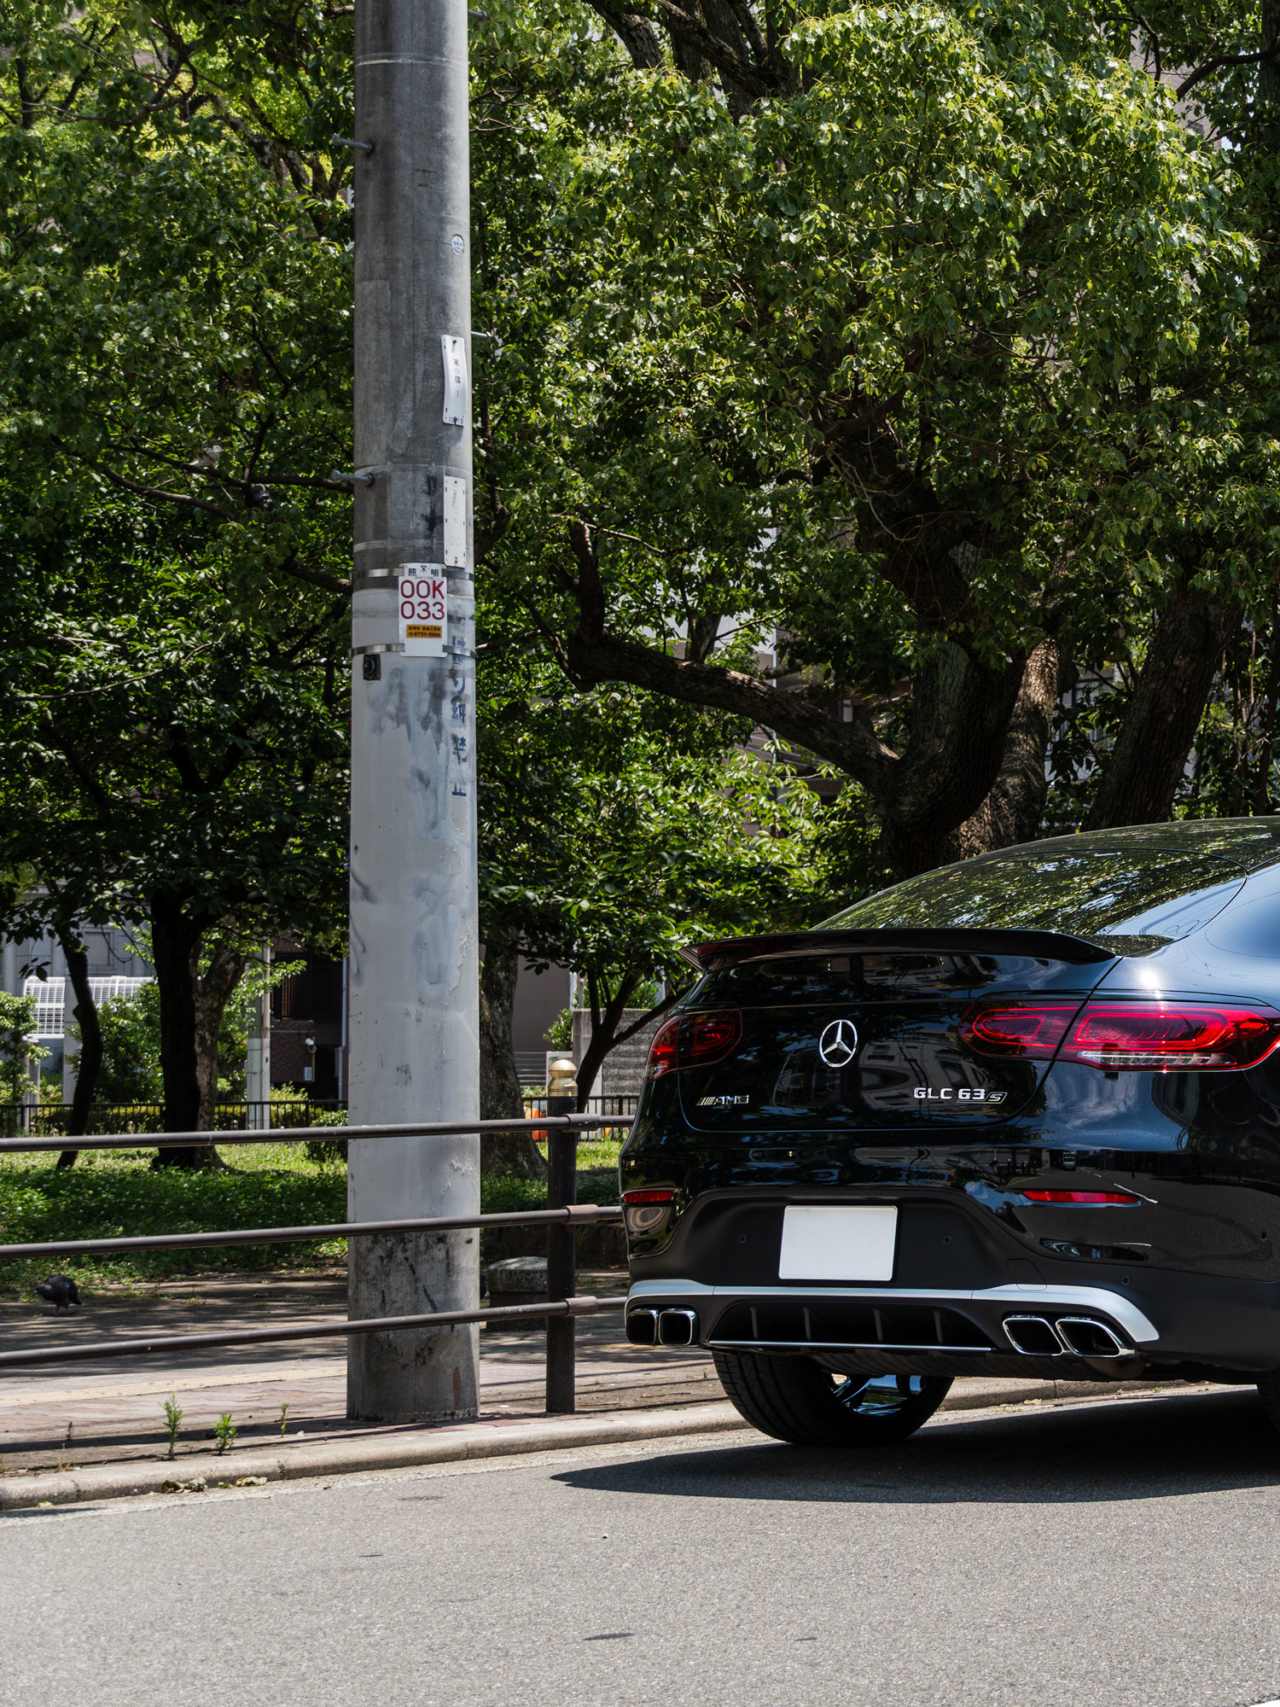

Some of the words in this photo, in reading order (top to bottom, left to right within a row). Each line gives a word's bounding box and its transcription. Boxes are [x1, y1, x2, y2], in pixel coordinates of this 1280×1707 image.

[400, 600, 445, 620] 033
[913, 1087, 953, 1099] GLC
[958, 1088, 986, 1100] 63
